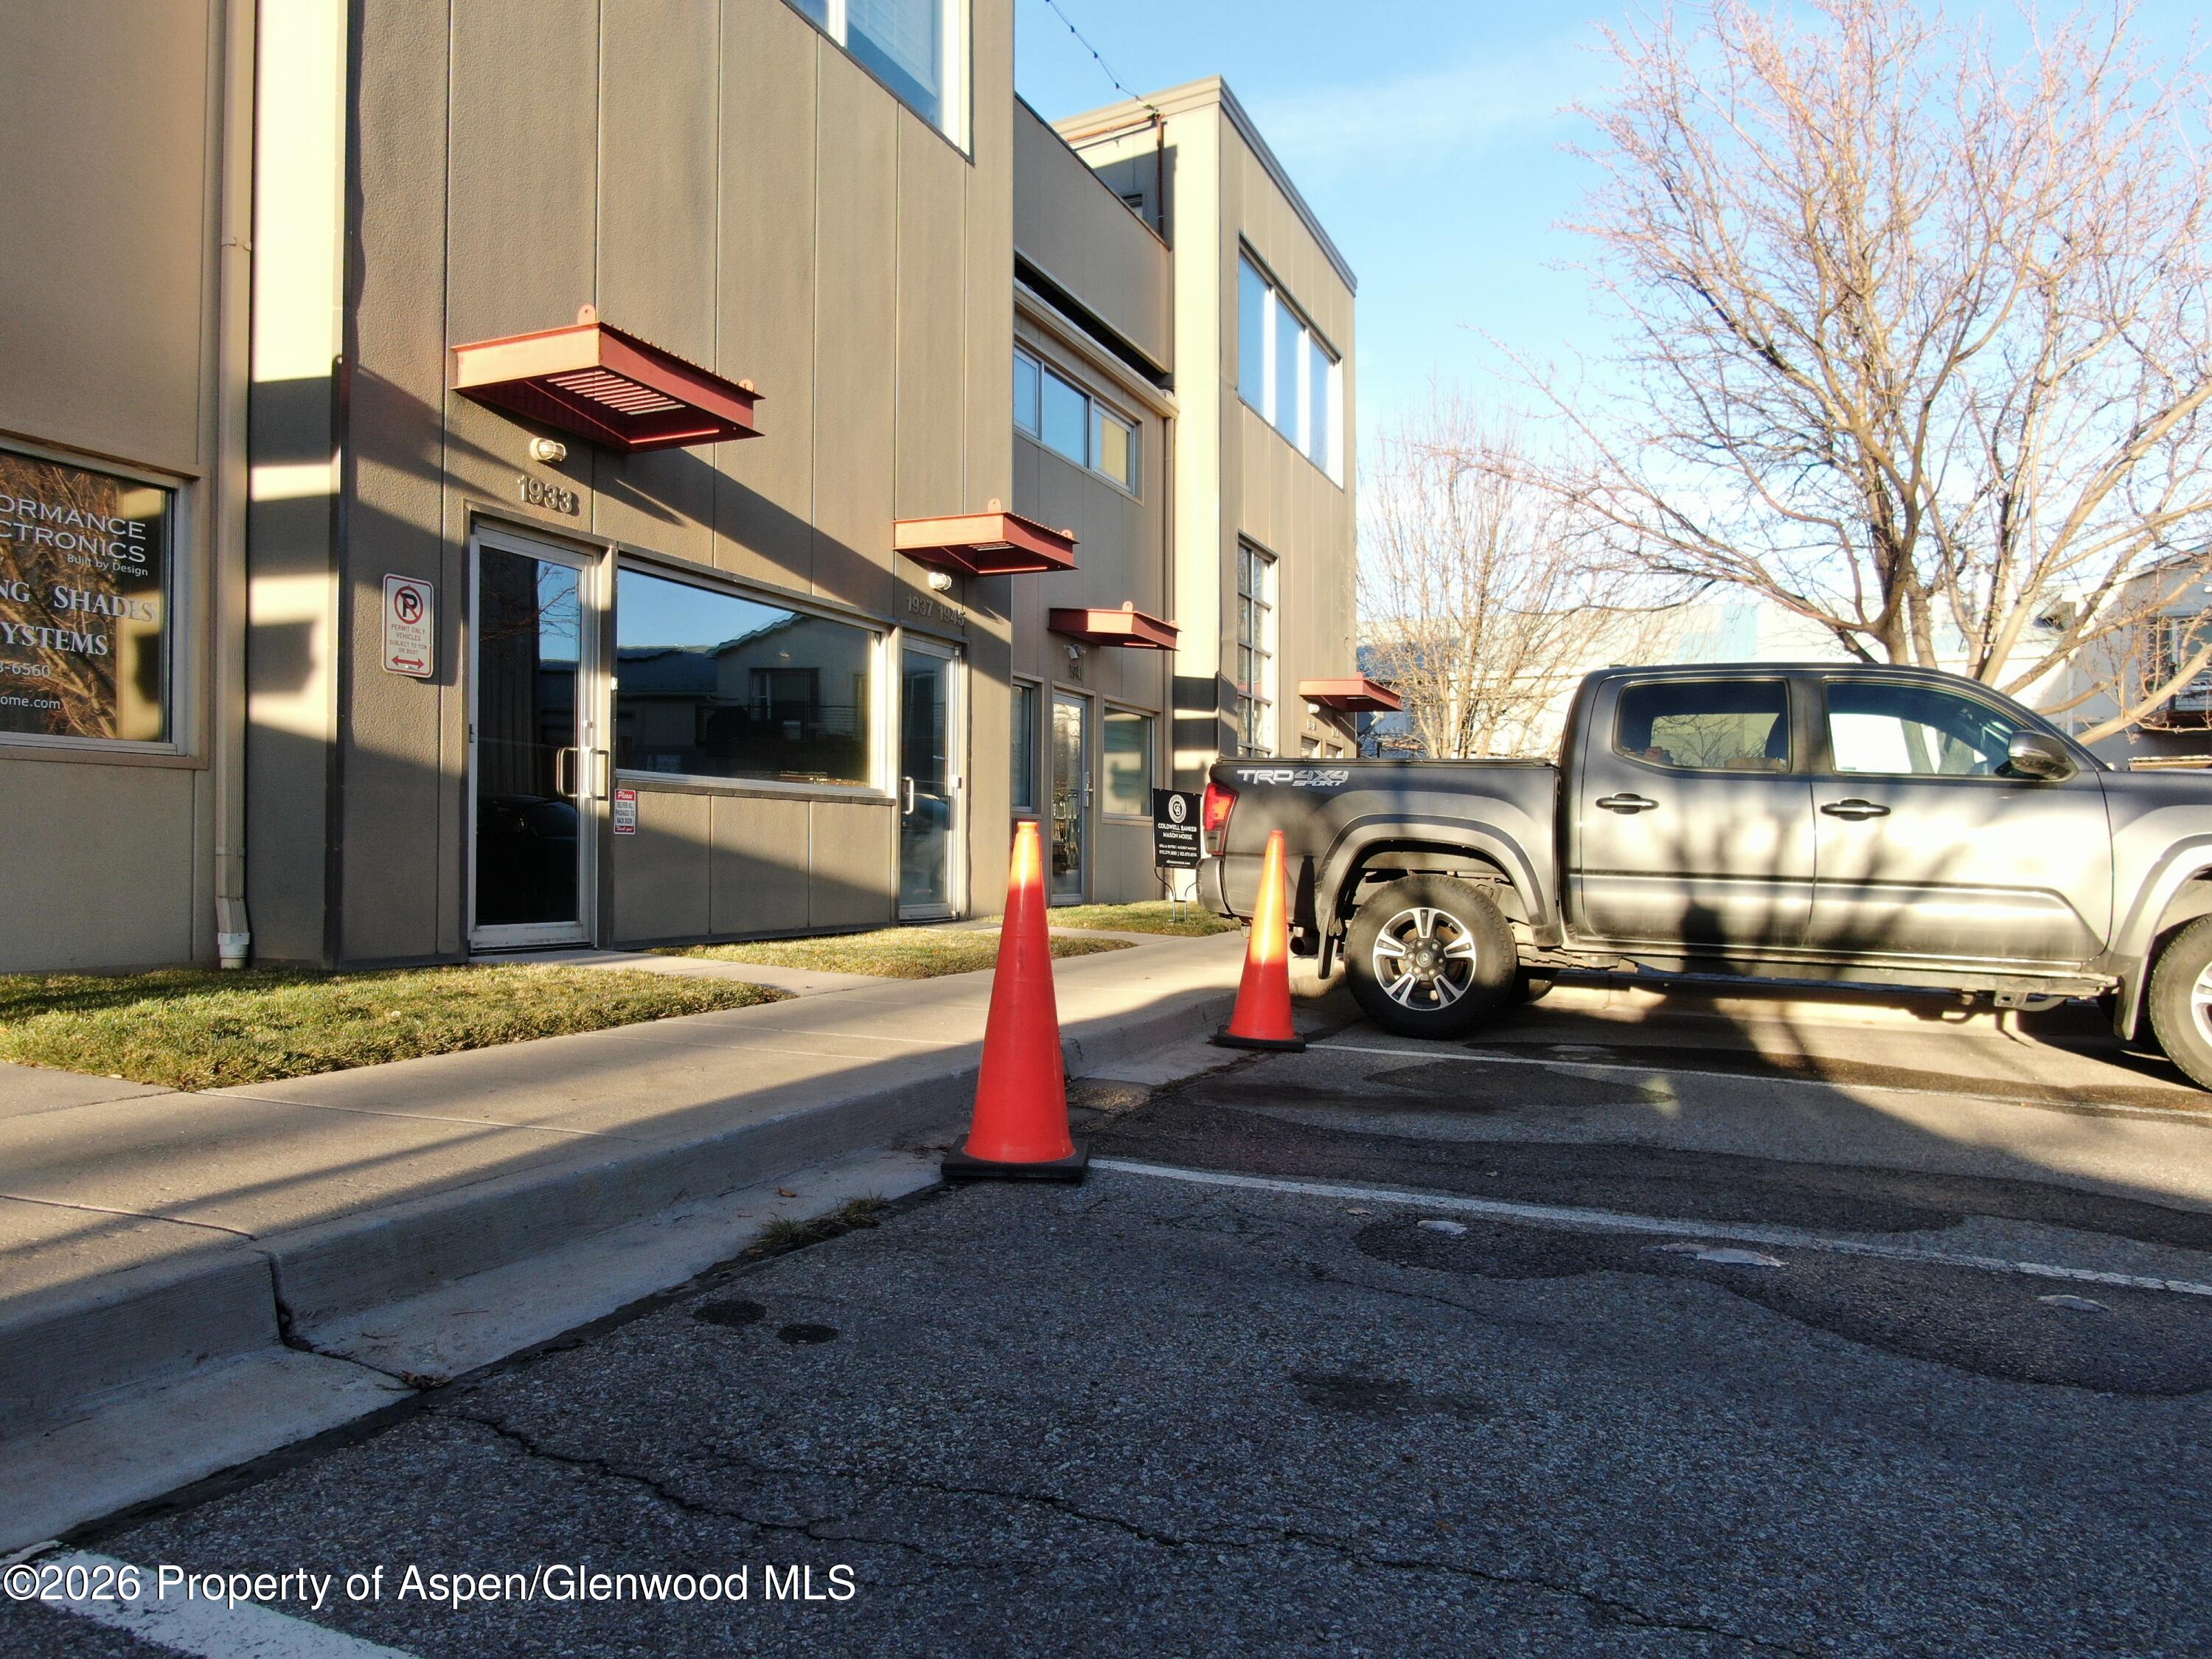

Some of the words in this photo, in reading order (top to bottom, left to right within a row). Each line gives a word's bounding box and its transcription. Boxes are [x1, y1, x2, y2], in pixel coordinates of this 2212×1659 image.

[518, 475, 573, 513] 1933
[67, 554, 91, 566] Built
[97, 559, 108, 571] by
[112, 563, 148, 577] Design
[54, 586, 156, 622] SHADES
[906, 593, 933, 618] 1937
[938, 605, 966, 627] 1945
[0, 621, 108, 655] YSTEMS
[391, 624, 410, 632] PERMIT
[397, 632, 421, 641] VEHICLES
[1237, 770, 1294, 785] TRD
